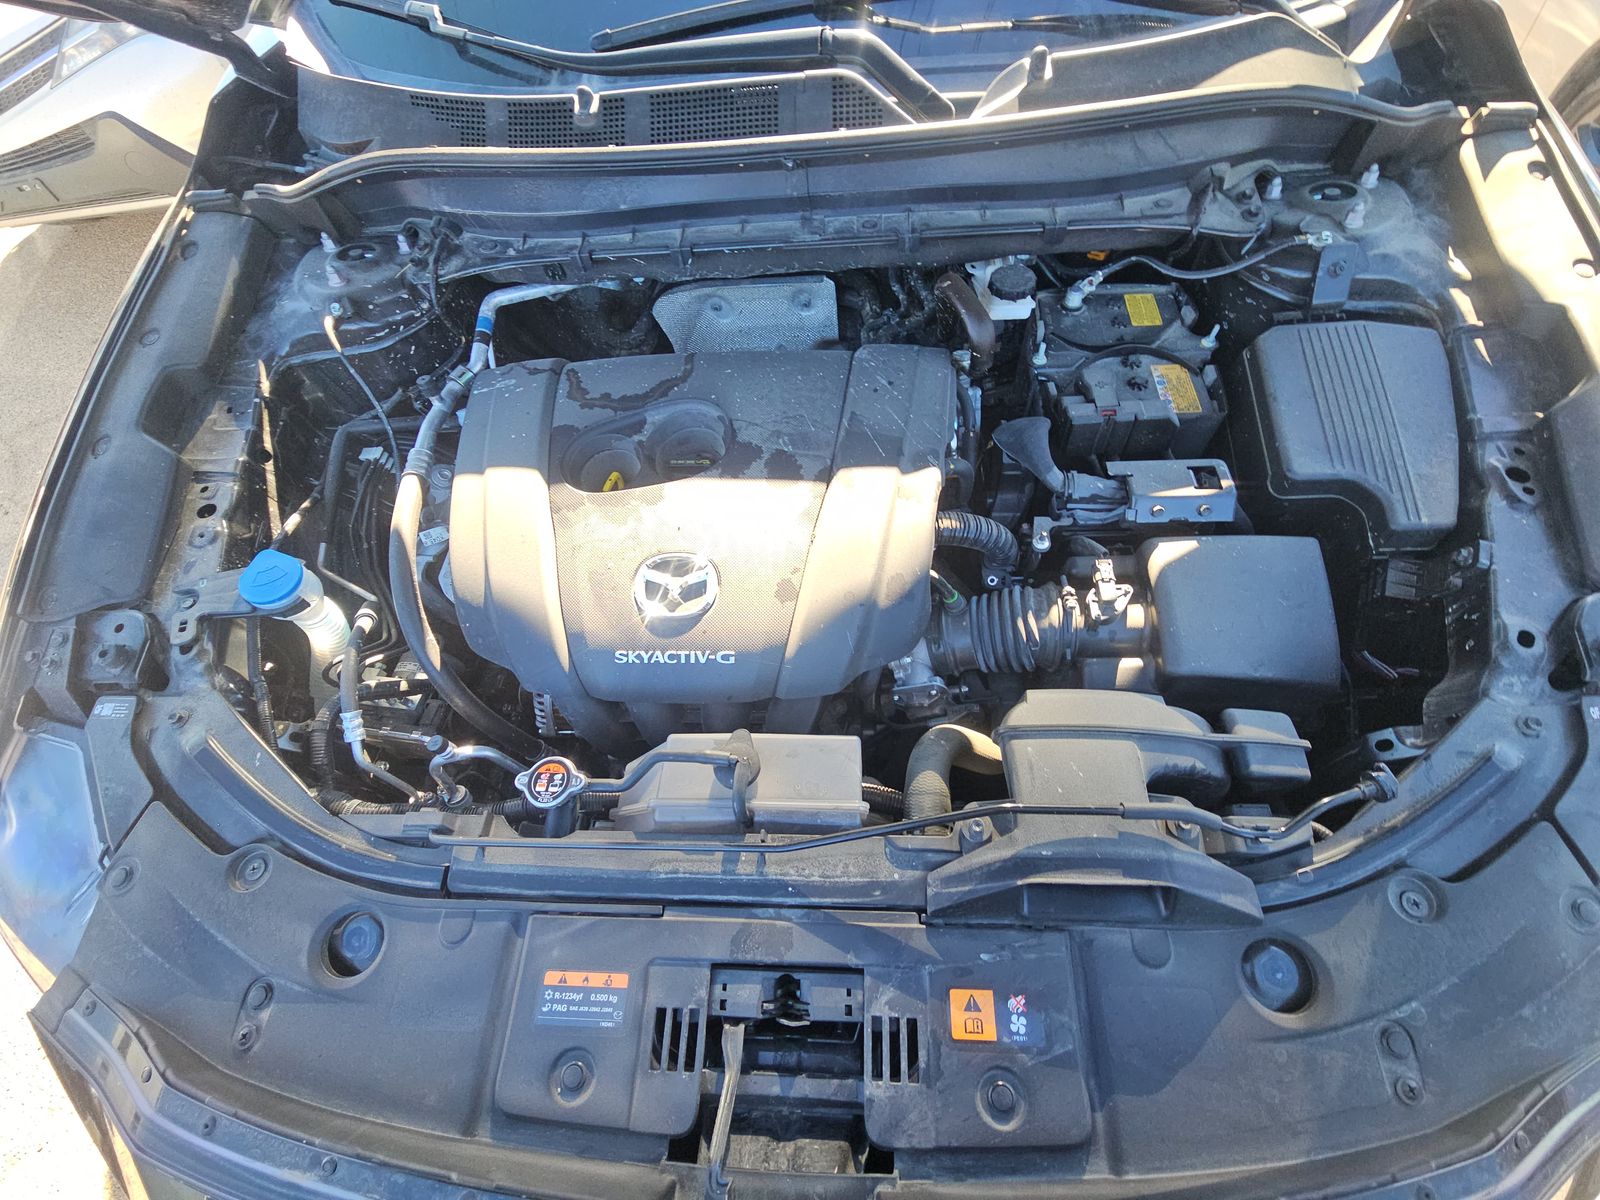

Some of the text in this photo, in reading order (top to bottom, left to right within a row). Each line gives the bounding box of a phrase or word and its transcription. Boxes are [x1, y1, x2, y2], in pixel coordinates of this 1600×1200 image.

[614, 650, 736, 664] SKYACTIV-G
[554, 992, 618, 1003] R-1234yf 0.500 kg
[552, 1003, 567, 1012] PAG
